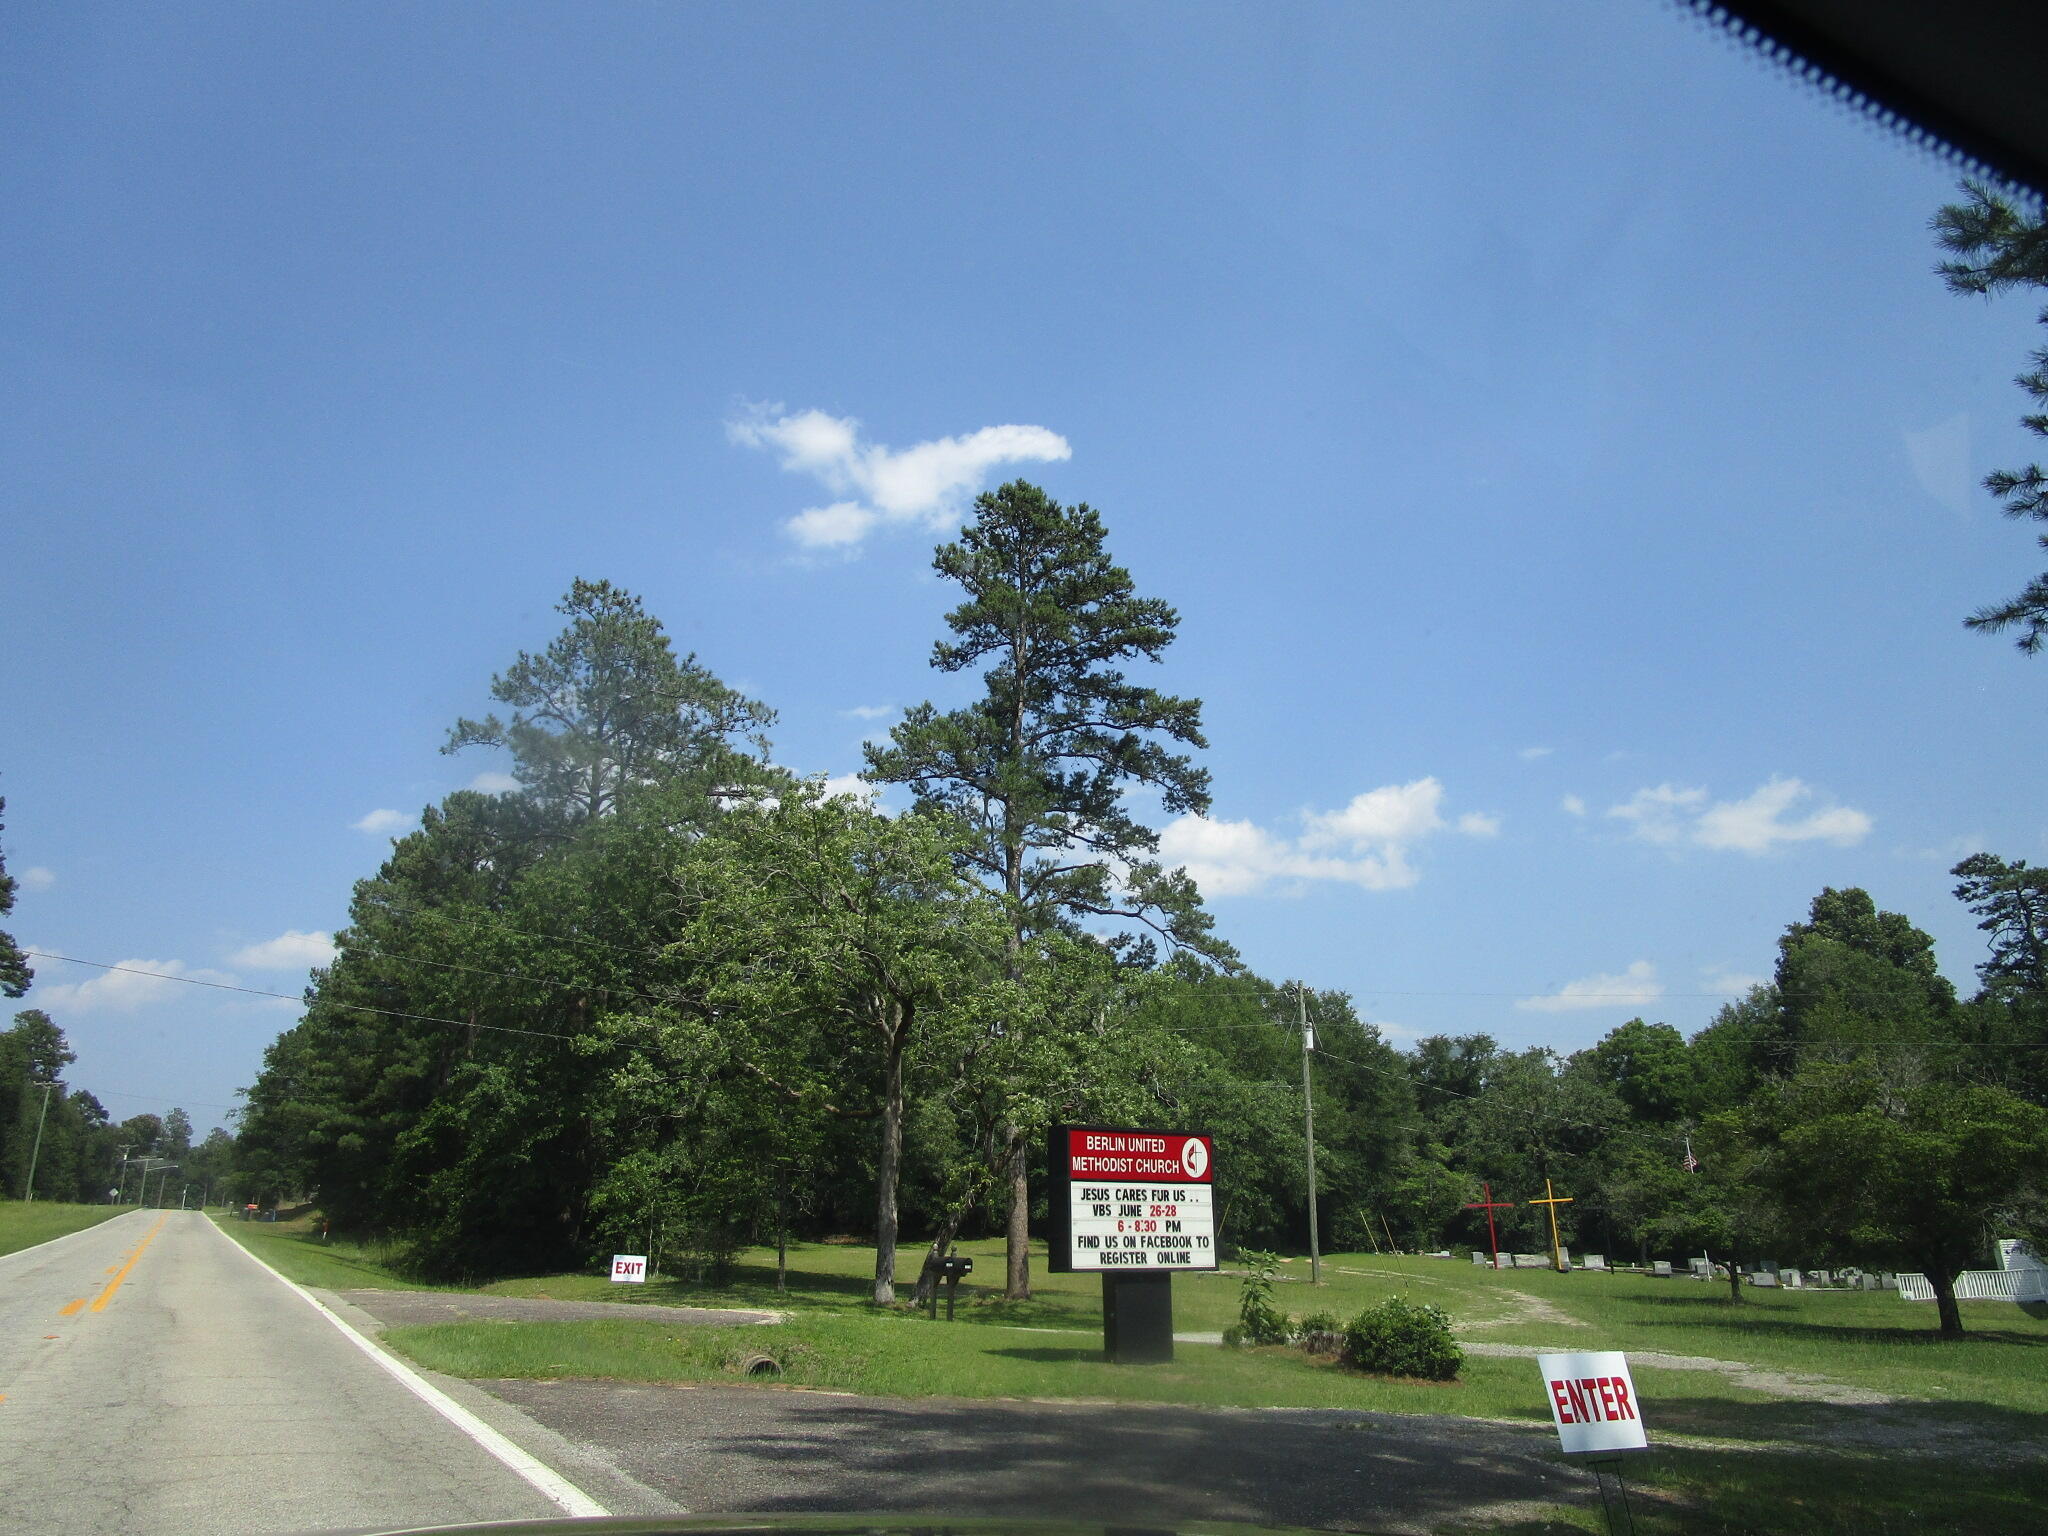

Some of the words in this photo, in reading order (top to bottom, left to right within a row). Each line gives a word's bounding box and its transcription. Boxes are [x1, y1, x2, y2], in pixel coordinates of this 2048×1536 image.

[1087, 1136, 1125, 1151] BERLIN
[1128, 1138, 1165, 1152] UNITED
[1072, 1157, 1133, 1172] METHODIST
[1136, 1159, 1180, 1174] CHURCH
[1081, 1188, 1109, 1201] JESUS
[1116, 1189, 1147, 1201] CARES
[1152, 1190, 1169, 1201] FUR
[1093, 1205, 1111, 1216] VBS
[1118, 1205, 1142, 1216] JUNE
[1150, 1205, 1176, 1217] 26-28
[1118, 1221, 1124, 1232] 6
[1135, 1221, 1156, 1232] 8:30
[1166, 1221, 1181, 1232] PM
[1078, 1236, 1099, 1248] FIND
[1105, 1236, 1118, 1247] US
[1123, 1236, 1136, 1247] ON
[1141, 1236, 1192, 1248] FACEBOOK
[1196, 1236, 1209, 1247] TO
[1100, 1252, 1147, 1264] REGISTER
[1158, 1252, 1191, 1263] ONLINE
[615, 1261, 643, 1275] EXIT
[1550, 1376, 1635, 1424] ENTER
